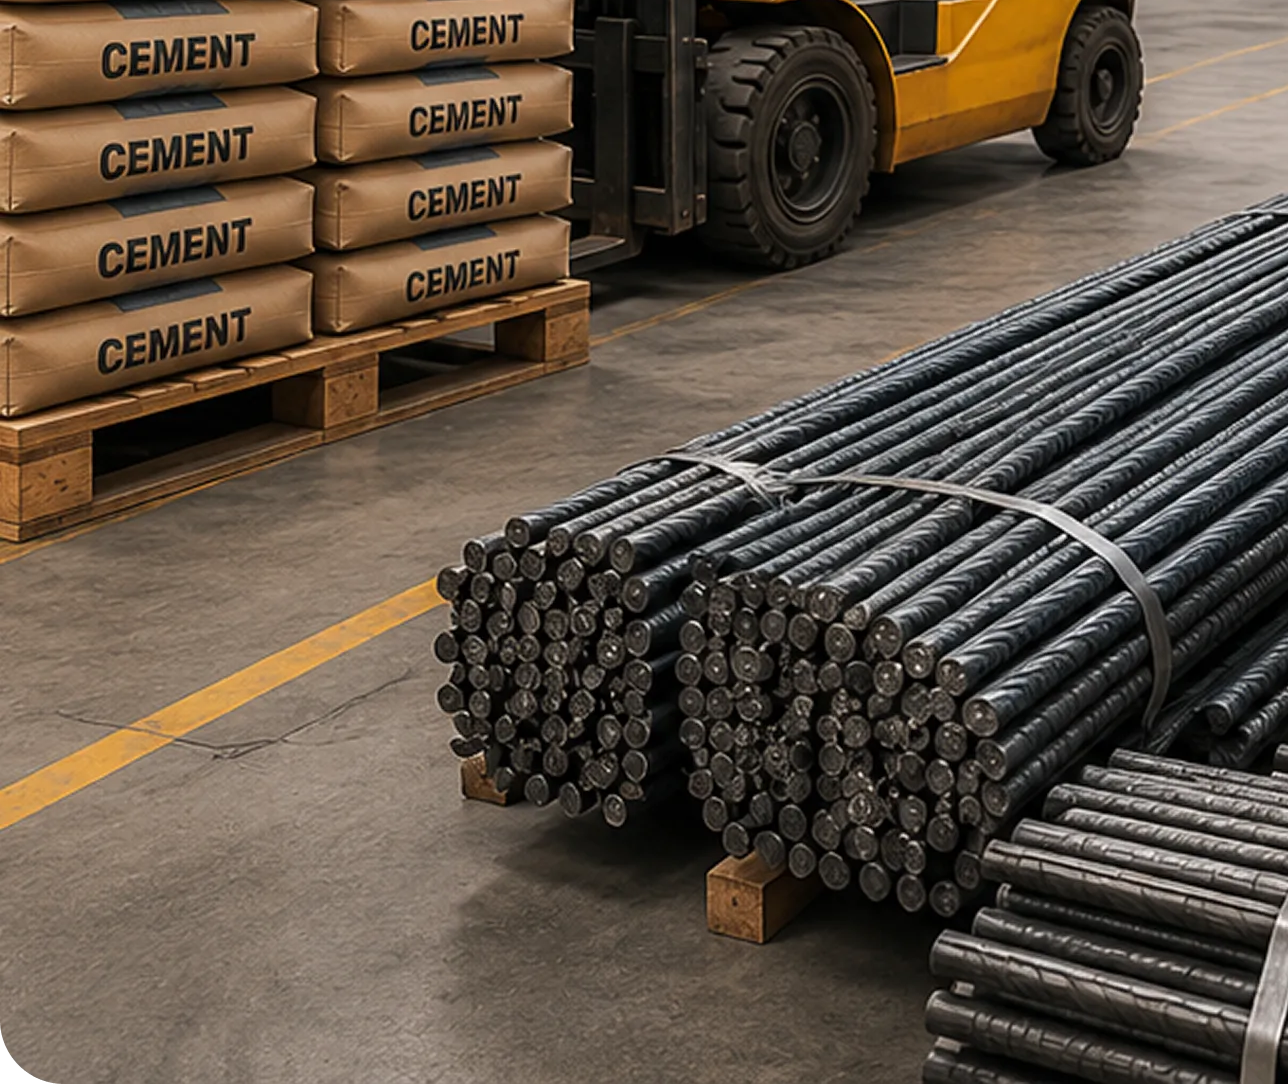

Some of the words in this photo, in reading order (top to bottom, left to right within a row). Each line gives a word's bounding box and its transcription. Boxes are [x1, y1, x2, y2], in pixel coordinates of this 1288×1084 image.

[101, 33, 256, 79] CEMENT
[410, 13, 524, 52] CEMENT
[409, 94, 523, 138] CEMENT
[99, 126, 254, 181] CEMENT
[408, 174, 522, 222] CEMENT
[98, 217, 252, 279] CEMENT
[405, 249, 521, 303] CEMENT
[97, 308, 252, 375] CEMENT
